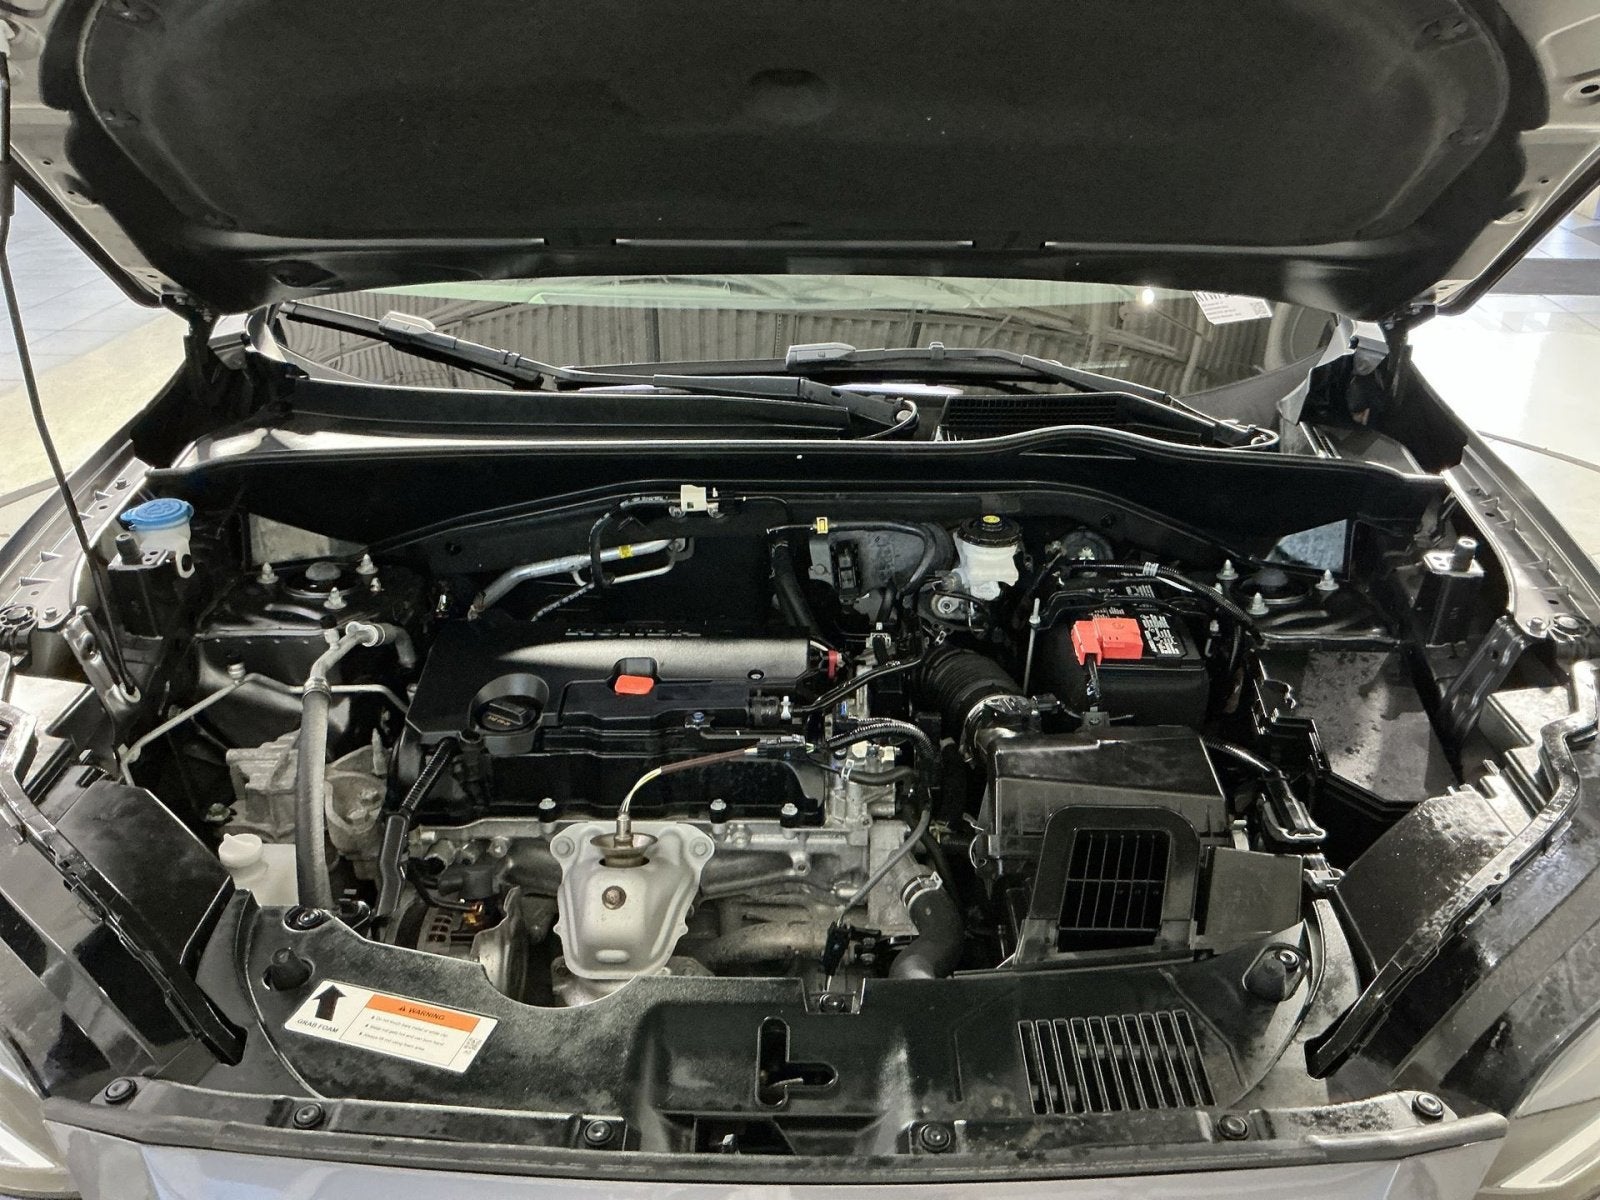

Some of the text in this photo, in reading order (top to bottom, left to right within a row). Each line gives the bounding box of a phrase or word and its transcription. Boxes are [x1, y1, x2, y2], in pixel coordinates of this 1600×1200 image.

[408, 1007, 445, 1021] WARNING
[297, 1019, 339, 1033] GRAB FOAM
